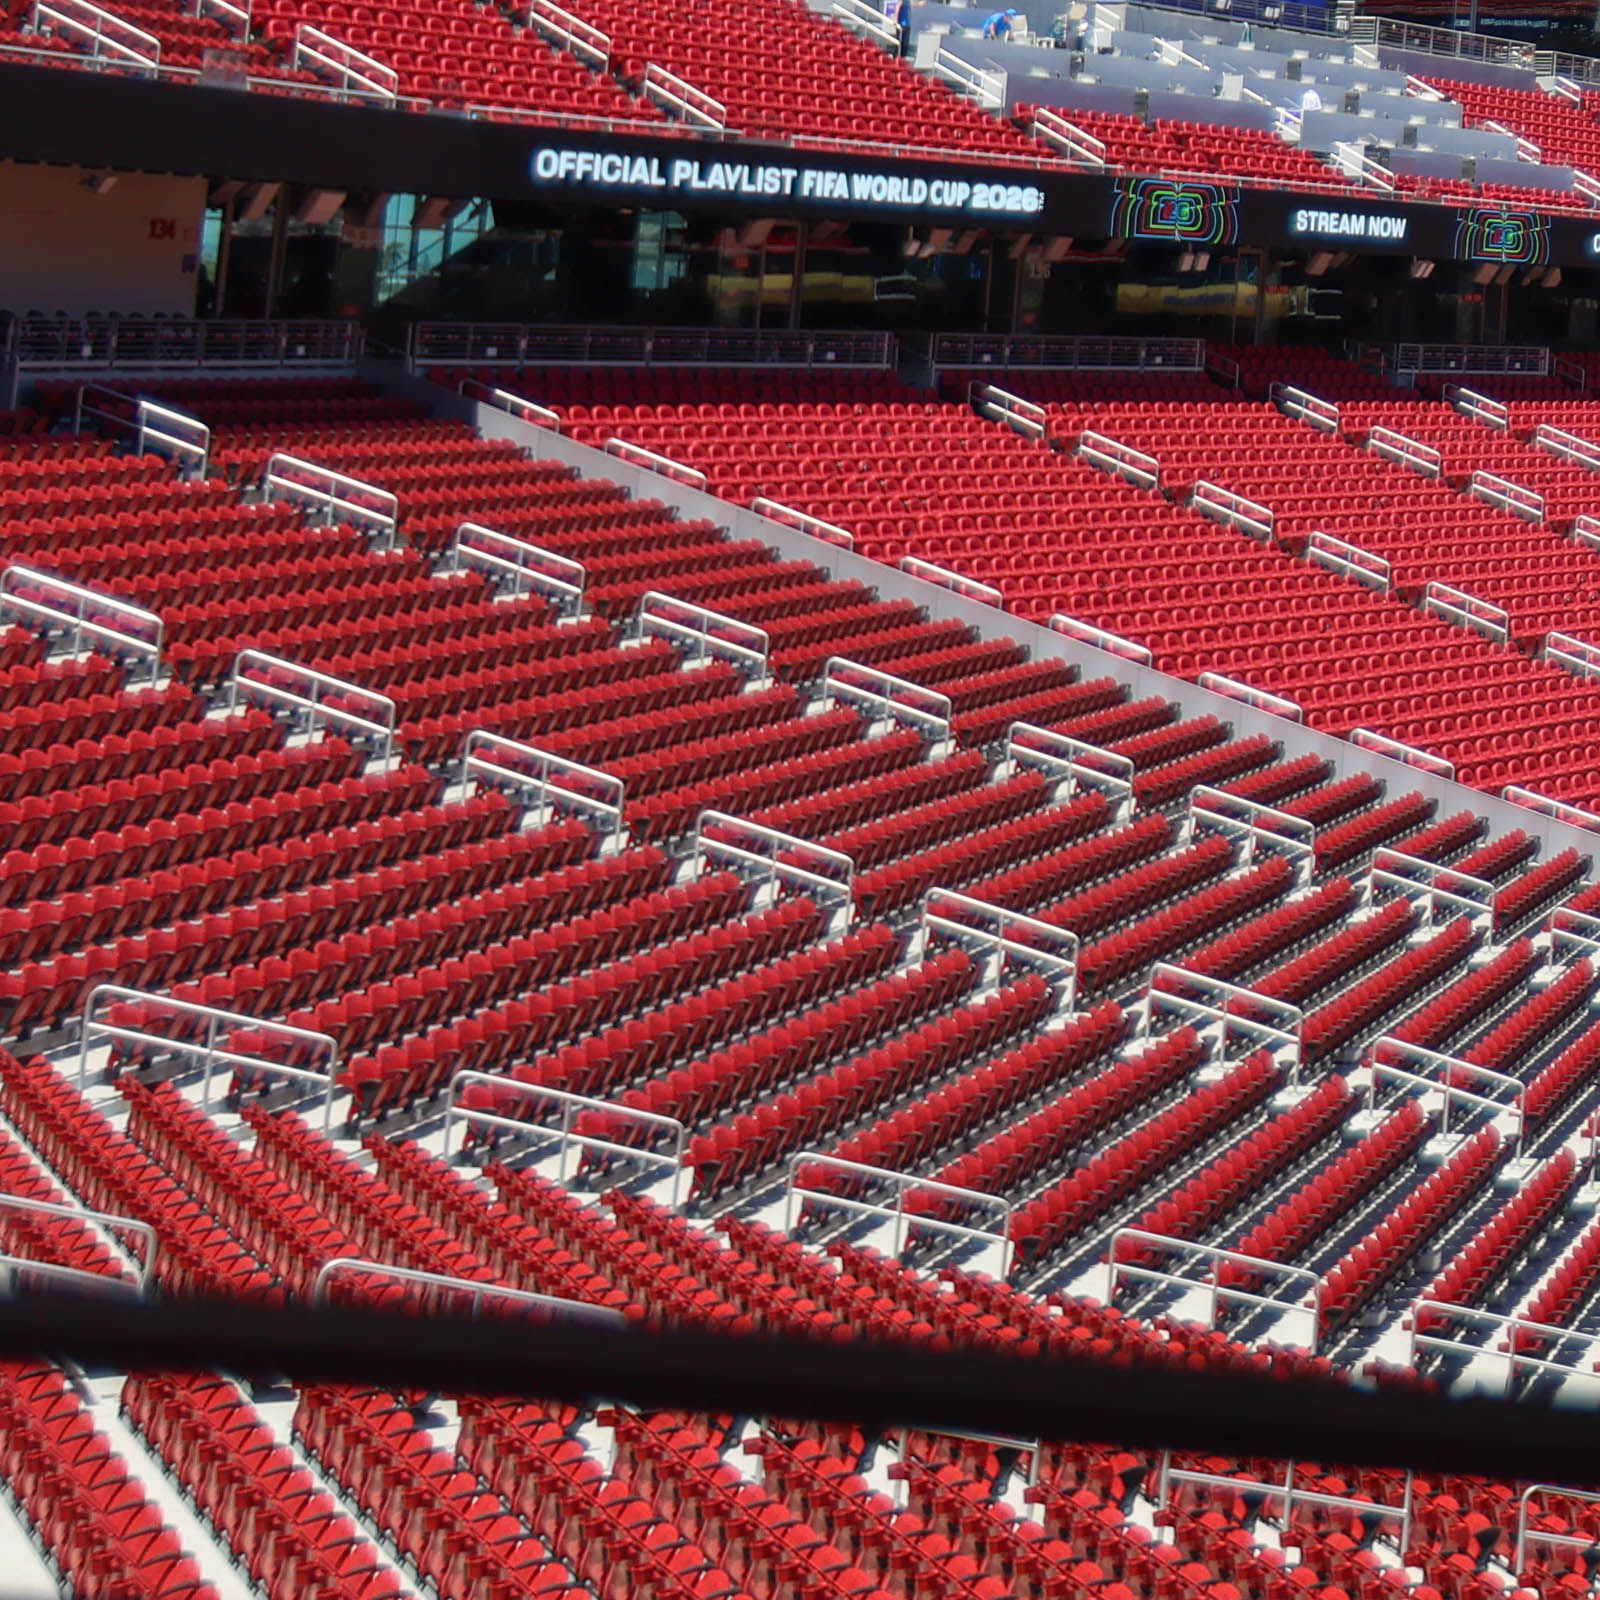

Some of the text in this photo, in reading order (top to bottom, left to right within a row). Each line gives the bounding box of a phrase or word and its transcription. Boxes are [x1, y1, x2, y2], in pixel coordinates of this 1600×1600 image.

[536, 148, 666, 186] OFFICIAL
[673, 159, 798, 195] PLAYLIST
[802, 169, 849, 199] FIFA
[852, 173, 928, 205] WORLD
[930, 180, 970, 207] CUP
[150, 219, 176, 239] 134
[1296, 209, 1406, 238] STREAM NOW
